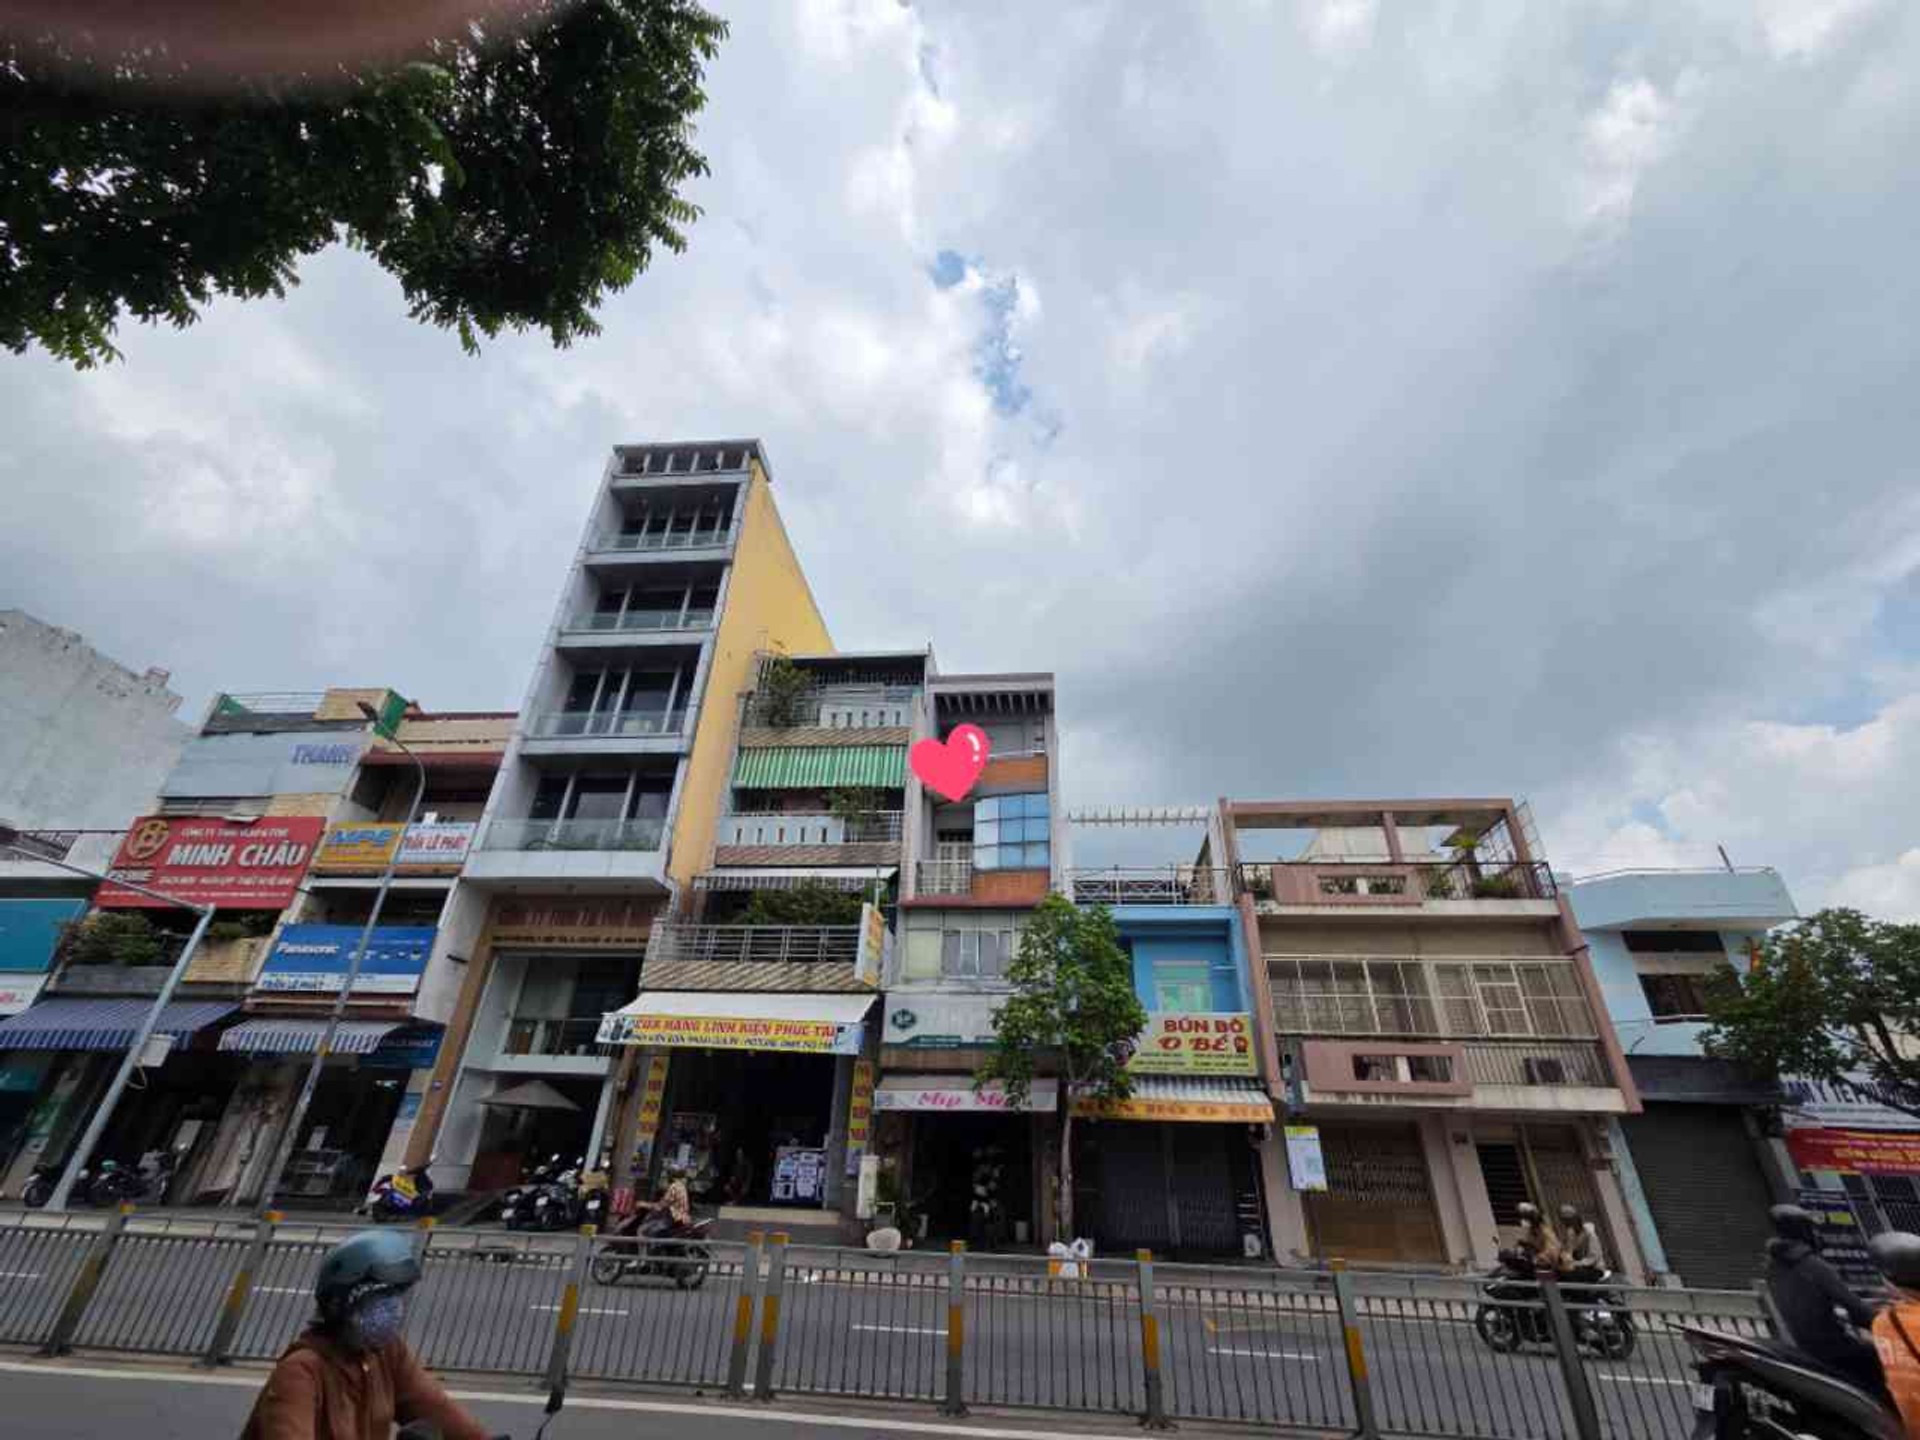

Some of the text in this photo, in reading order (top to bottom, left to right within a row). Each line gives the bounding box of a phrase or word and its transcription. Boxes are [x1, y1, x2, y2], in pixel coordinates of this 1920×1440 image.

[166, 844, 235, 867] MINH
[237, 839, 309, 867] CHÂU
[276, 942, 340, 955] Panasonic
[1163, 1015, 1210, 1034] BÚN
